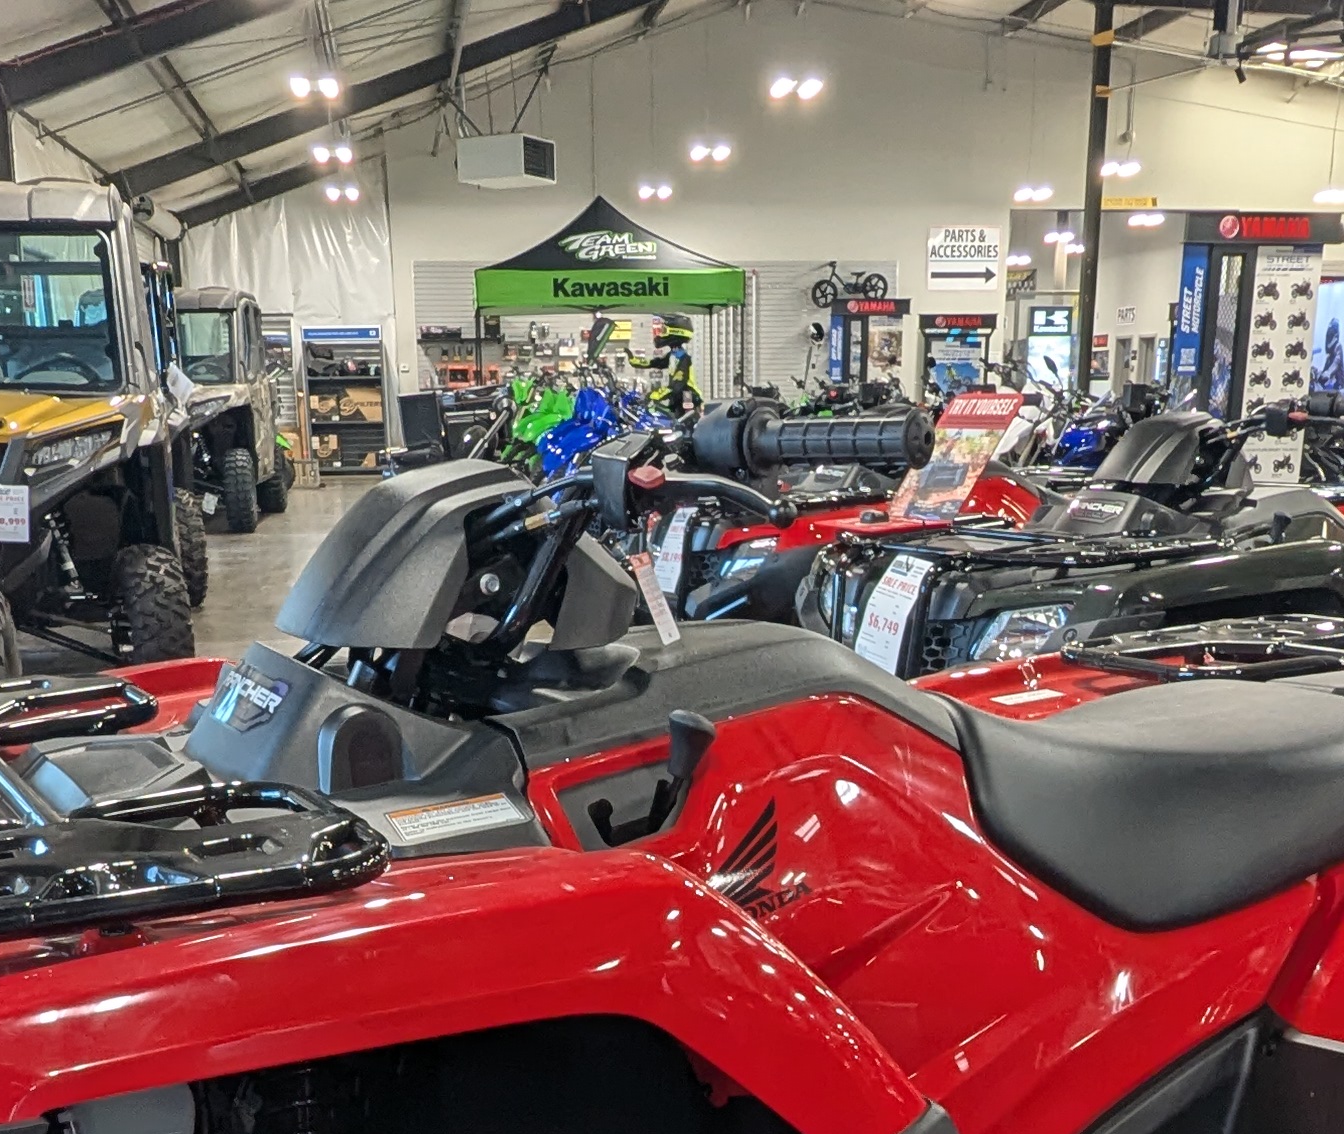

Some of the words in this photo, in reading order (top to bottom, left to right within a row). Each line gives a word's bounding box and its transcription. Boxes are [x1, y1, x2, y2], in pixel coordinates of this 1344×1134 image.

[943, 229, 976, 242] PARTS
[978, 229, 987, 242] &
[1241, 216, 1311, 239] YAMAHA
[559, 230, 631, 250] TEAM
[577, 242, 655, 260] GREEN
[929, 245, 998, 258] ACCESSORIES
[552, 276, 669, 298] Kawasaki
[859, 301, 896, 312] YAMAHA
[1180, 287, 1194, 334] STREET
[1190, 267, 1205, 334] MOTORCYCLE
[1117, 307, 1136, 322] PARTS
[972, 398, 1019, 415] YOURSELF
[881, 576, 899, 591] SALE
[896, 579, 918, 595] PRICE
[868, 612, 899, 636] $6,749
[223, 671, 284, 713] RANCHER
[742, 882, 812, 919] ONDA
